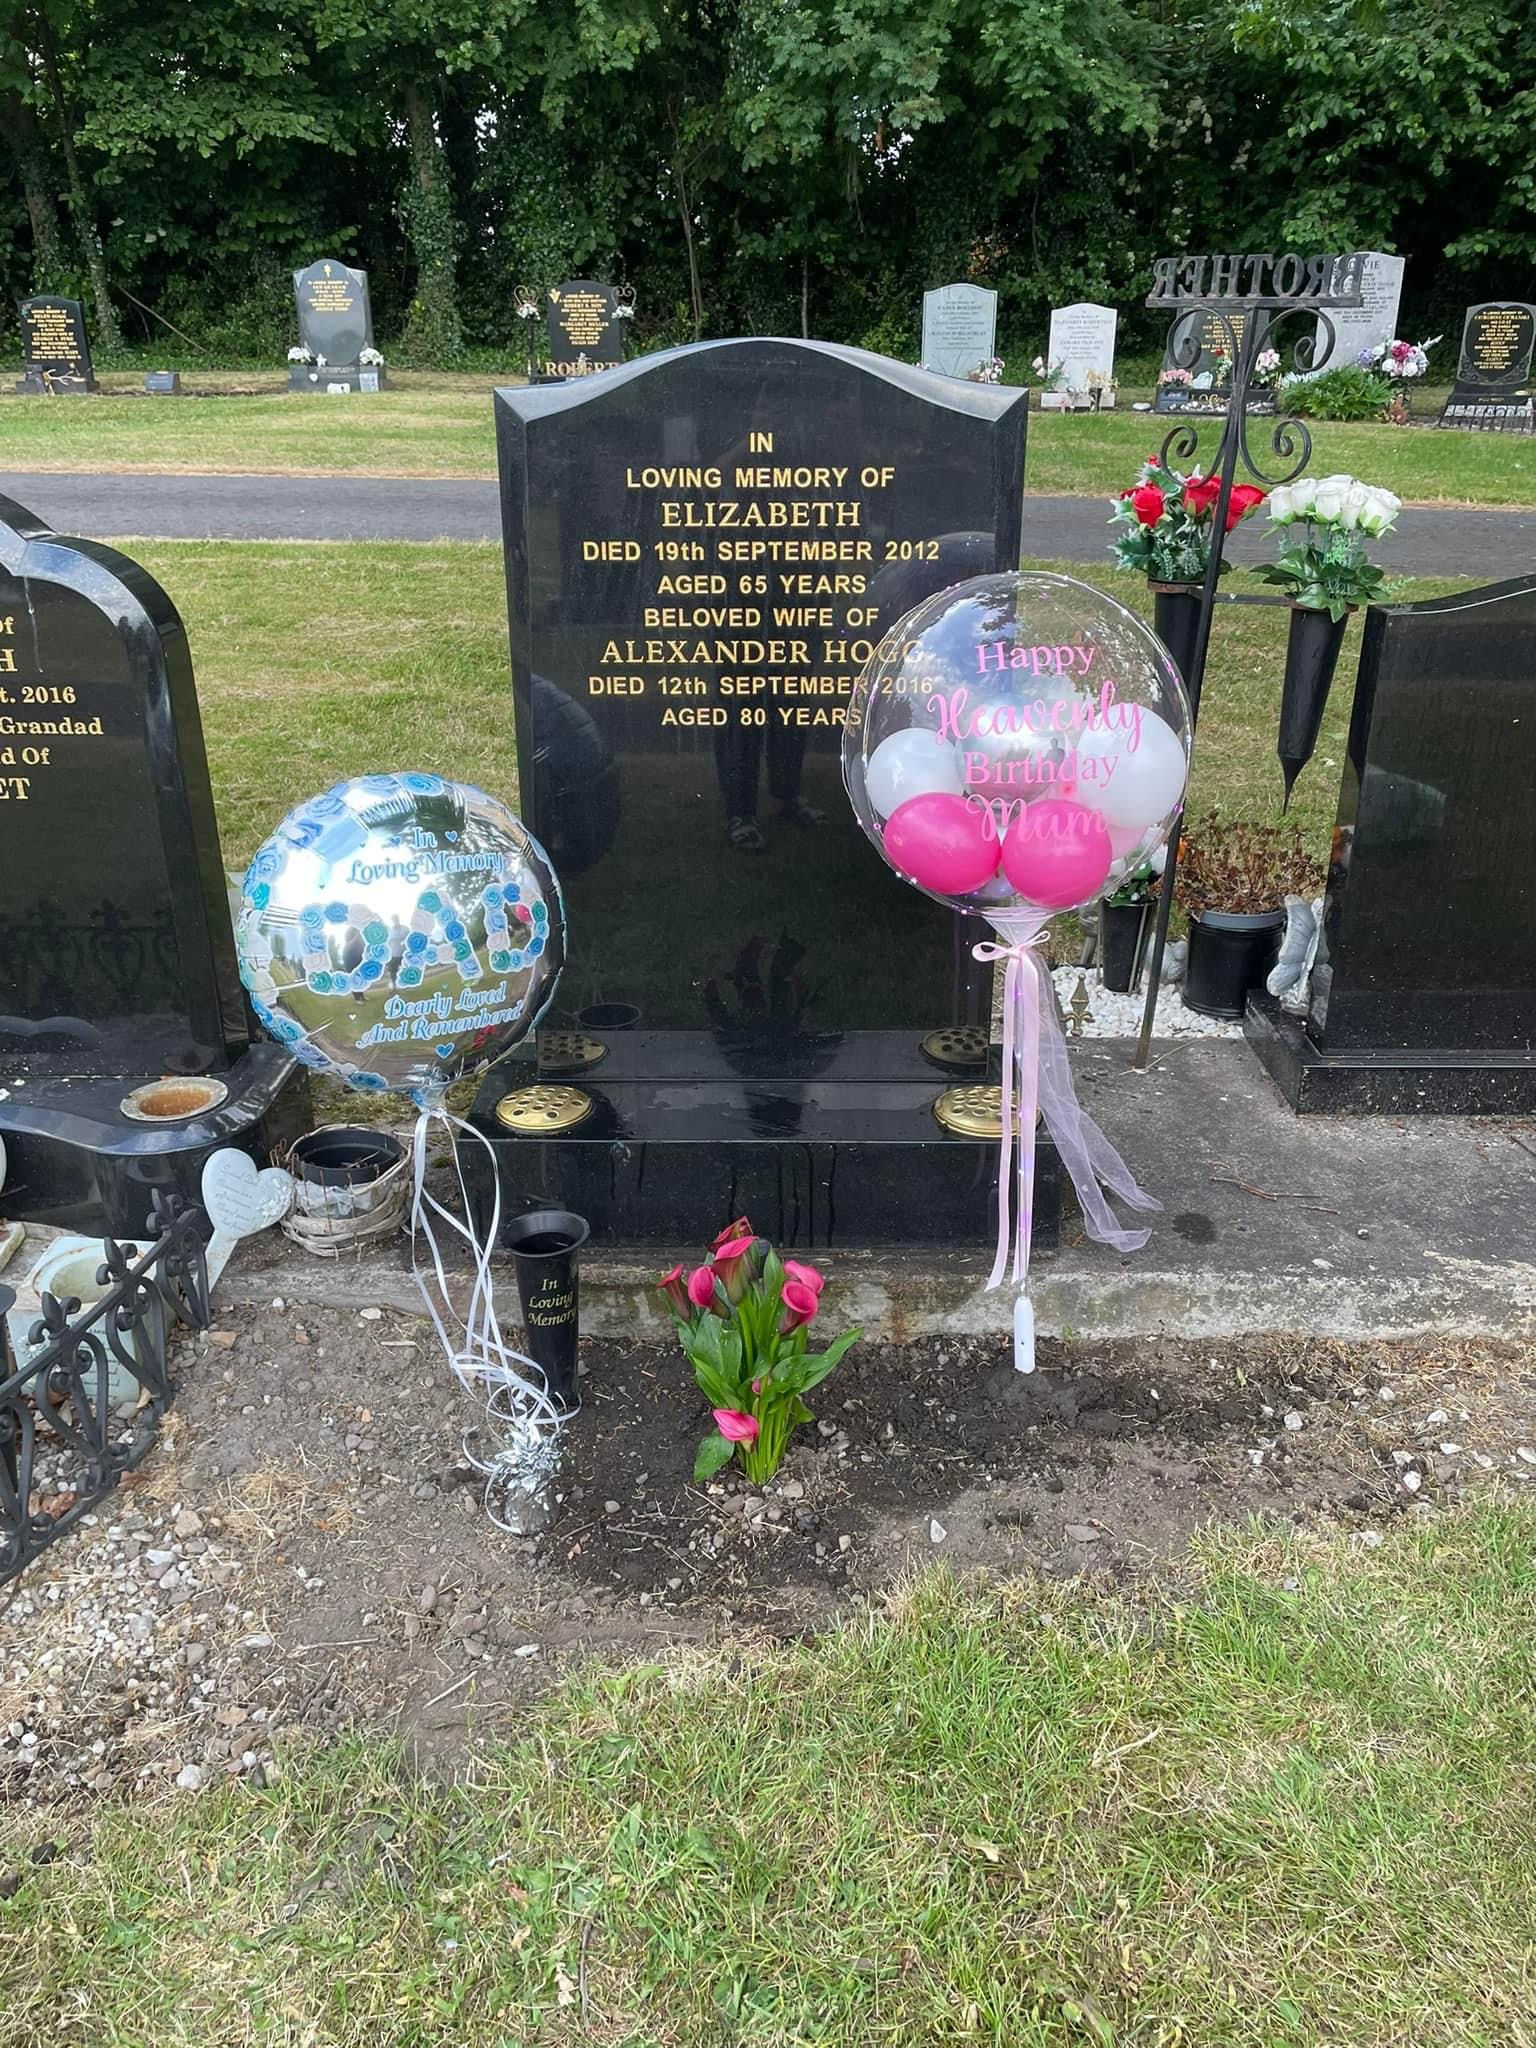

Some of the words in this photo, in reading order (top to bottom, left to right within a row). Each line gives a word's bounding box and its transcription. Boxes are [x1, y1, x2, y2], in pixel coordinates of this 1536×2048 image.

[750, 432, 773, 453] IN
[626, 467, 722, 488] LOVING
[735, 467, 848, 488] MEMORY
[860, 466, 896, 487] OF
[661, 502, 861, 527] ELIZABETH
[583, 541, 641, 561] DIED
[654, 541, 705, 561] 19th
[718, 541, 873, 561] SEPTEMBER
[885, 541, 940, 560] 2012
[657, 575, 726, 594] AGED
[739, 575, 767, 594] 65
[780, 575, 866, 594] YEARS
[644, 607, 761, 627] BELOVED
[774, 607, 833, 627] WIFE
[846, 607, 879, 627] OF
[600, 640, 811, 664] ALEXANDER
[824, 639, 923, 664] HOGG
[975, 641, 1095, 677] Happy
[22, 686, 77, 704] 2016
[588, 676, 645, 695] DIED
[658, 676, 707, 695] 12th
[720, 676, 869, 695] SEPTEMBER
[881, 676, 933, 694] 2016
[0, 717, 104, 735] Grandad
[661, 707, 727, 726] AGED
[740, 707, 766, 726] 80
[778, 707, 862, 726] YEARS
[927, 680, 1144, 752] Heavenly
[22, 747, 50, 765] Of
[964, 751, 1119, 788] Birthday
[965, 793, 1108, 843] Mum
[413, 826, 438, 849] In
[347, 857, 421, 885] Loving
[422, 851, 505, 874] Memory
[301, 882, 549, 996] DAD
[384, 991, 453, 1021] Dearly
[455, 981, 506, 1011] Loved
[356, 1023, 408, 1049] And
[412, 1001, 523, 1040] Remembered
[541, 1279, 558, 1291] In
[528, 1291, 574, 1309] Loving
[528, 1307, 576, 1327] Memory
